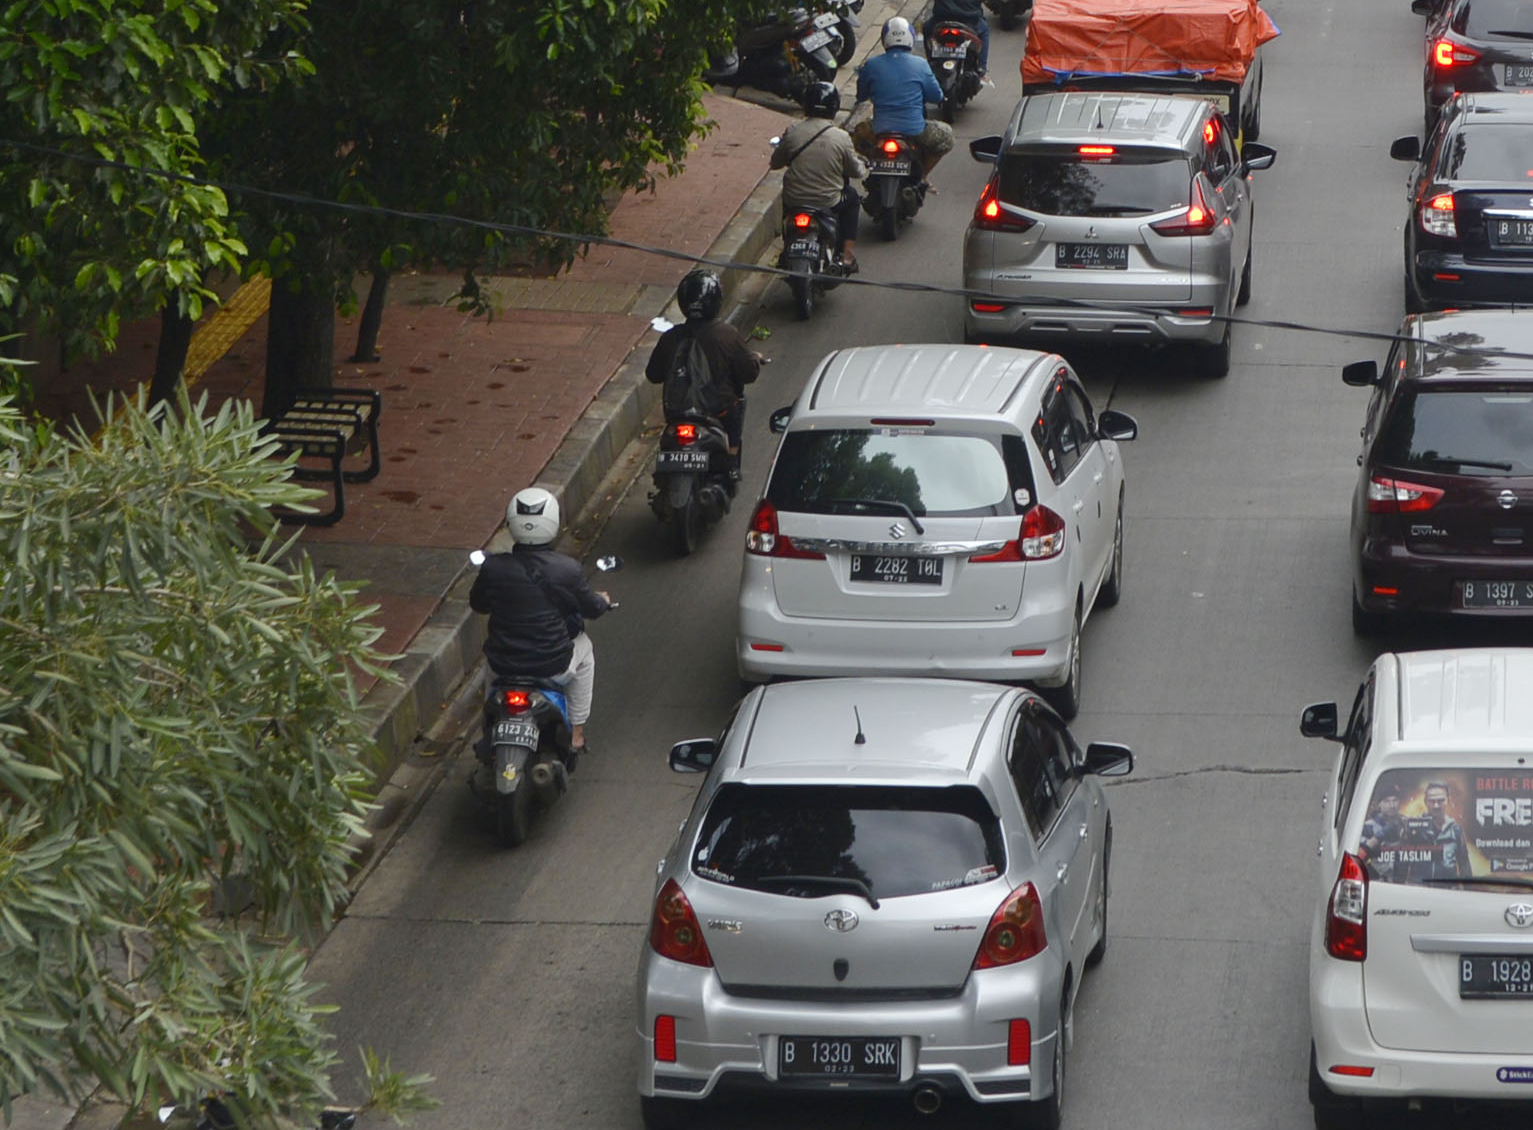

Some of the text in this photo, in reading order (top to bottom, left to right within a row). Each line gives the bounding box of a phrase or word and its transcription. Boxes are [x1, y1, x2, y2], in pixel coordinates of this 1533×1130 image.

[1501, 222, 1509, 236] B
[1059, 245, 1066, 258] B
[852, 556, 861, 572] B
[875, 557, 908, 575] 2282
[1466, 582, 1474, 599] B
[1486, 582, 1515, 599] 1397
[1476, 777, 1518, 791] BATTLE
[1475, 838, 1531, 847] Download dan
[1377, 850, 1432, 862] JOE TASLIM
[1462, 960, 1473, 981] B
[1491, 960, 1532, 982] 1928
[785, 1042, 896, 1064] B 1330 SRK
